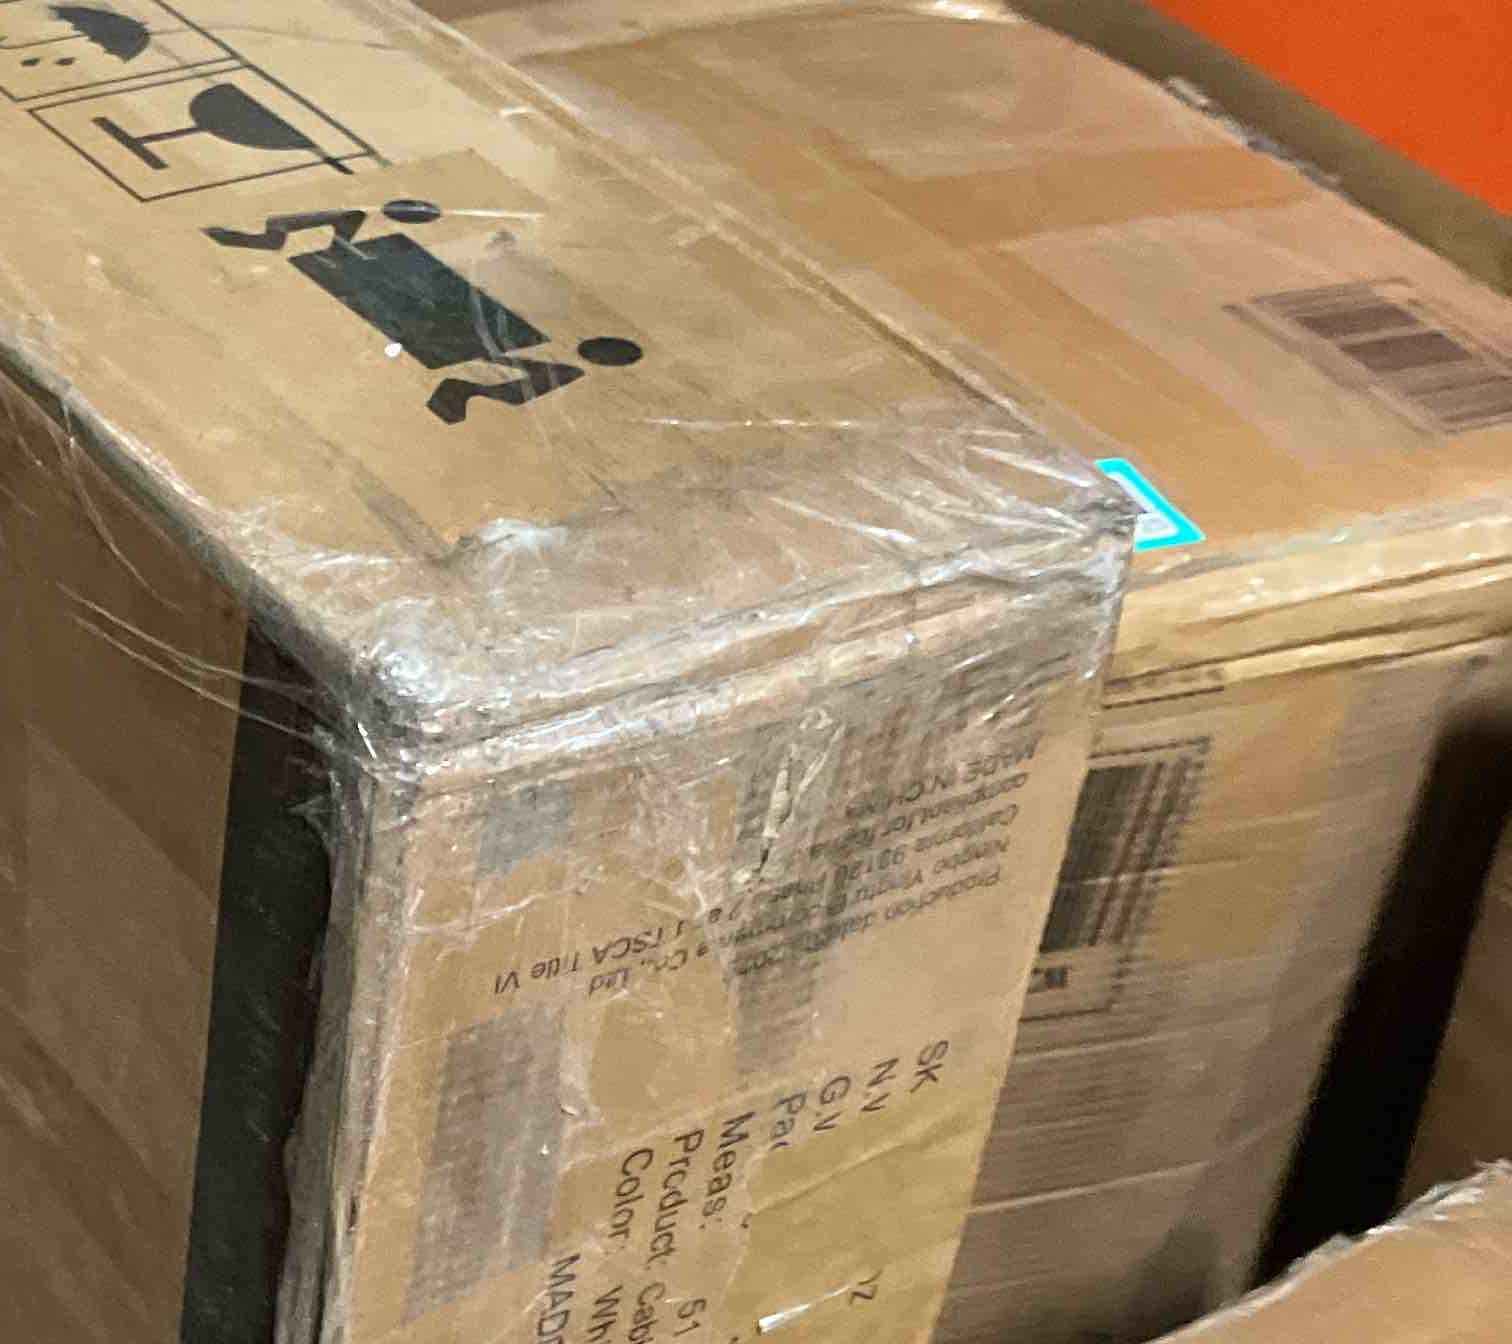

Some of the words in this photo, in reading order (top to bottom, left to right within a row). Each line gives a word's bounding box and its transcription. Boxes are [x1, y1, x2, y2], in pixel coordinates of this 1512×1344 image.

[591, 926, 665, 965] TSCA
[529, 951, 581, 981] Title
[493, 970, 522, 997] VI
